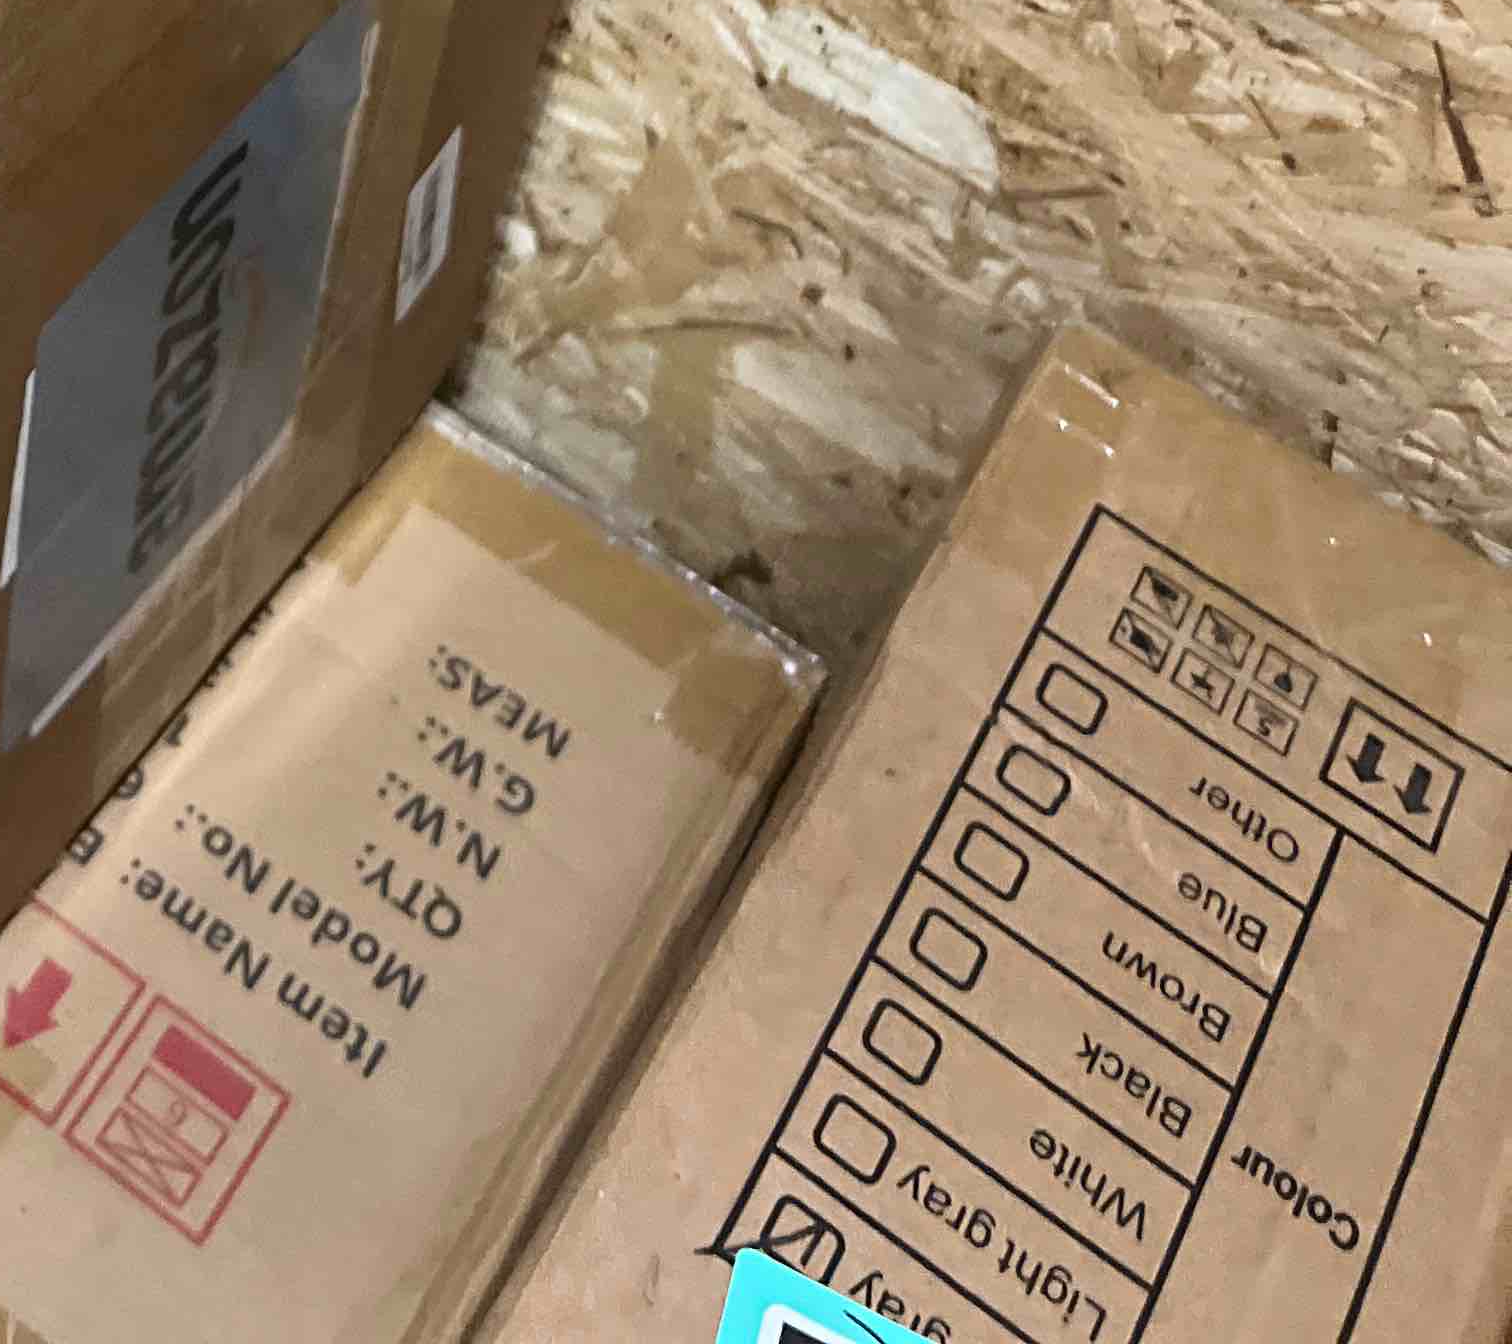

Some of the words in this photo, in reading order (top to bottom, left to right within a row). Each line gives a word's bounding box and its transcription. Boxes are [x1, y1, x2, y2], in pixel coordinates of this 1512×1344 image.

[427, 644, 572, 761] MEAS:
[416, 716, 538, 816] G.W.:
[174, 803, 271, 896] No.:
[377, 769, 502, 883] N.W.:
[1187, 776, 1300, 865] Other
[119, 857, 272, 992] Name:
[268, 877, 428, 1012] Model
[355, 842, 464, 941] QTY:
[1176, 870, 1269, 954] Blue
[275, 972, 386, 1080] Item
[1101, 930, 1232, 1044] Brown
[1075, 1031, 1193, 1139] Black
[895, 1163, 998, 1251] gray
[1028, 1127, 1148, 1243] White
[1229, 1143, 1361, 1252] Colour
[997, 1235, 1107, 1343] Light
